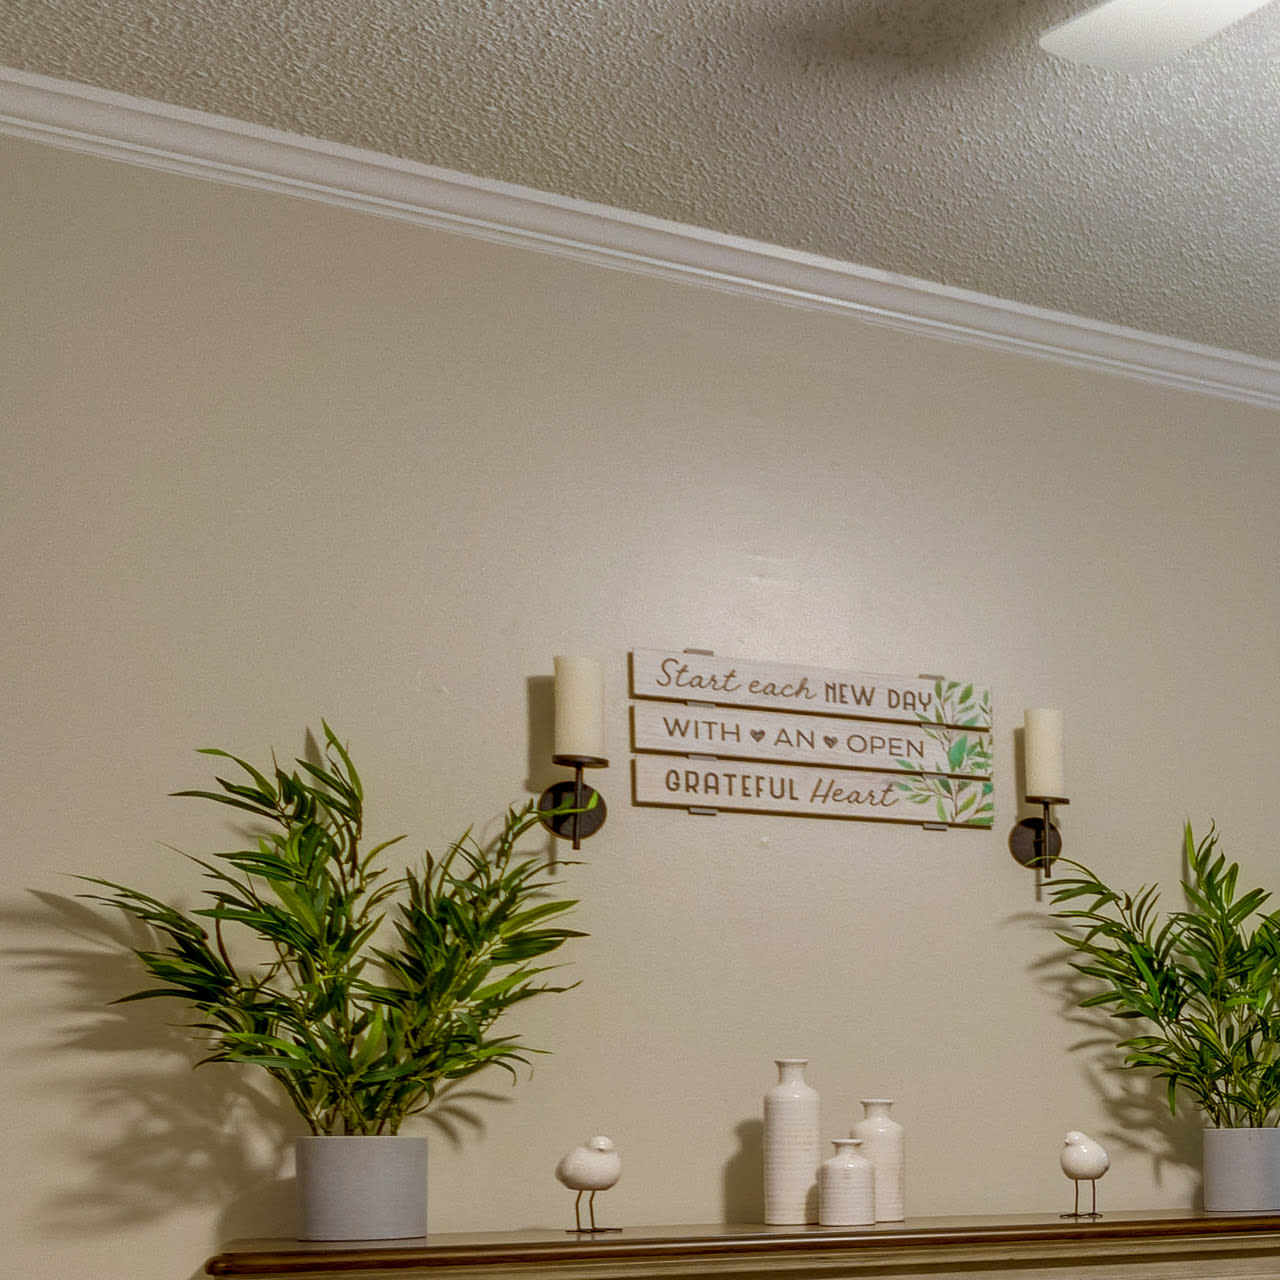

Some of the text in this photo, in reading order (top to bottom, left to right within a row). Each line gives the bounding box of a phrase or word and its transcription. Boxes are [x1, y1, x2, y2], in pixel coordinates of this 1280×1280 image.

[655, 657, 933, 713] Start each NEW DAY
[662, 717, 925, 759] WITH AN OPEN
[665, 769, 899, 808] GRATEFUL Heart
